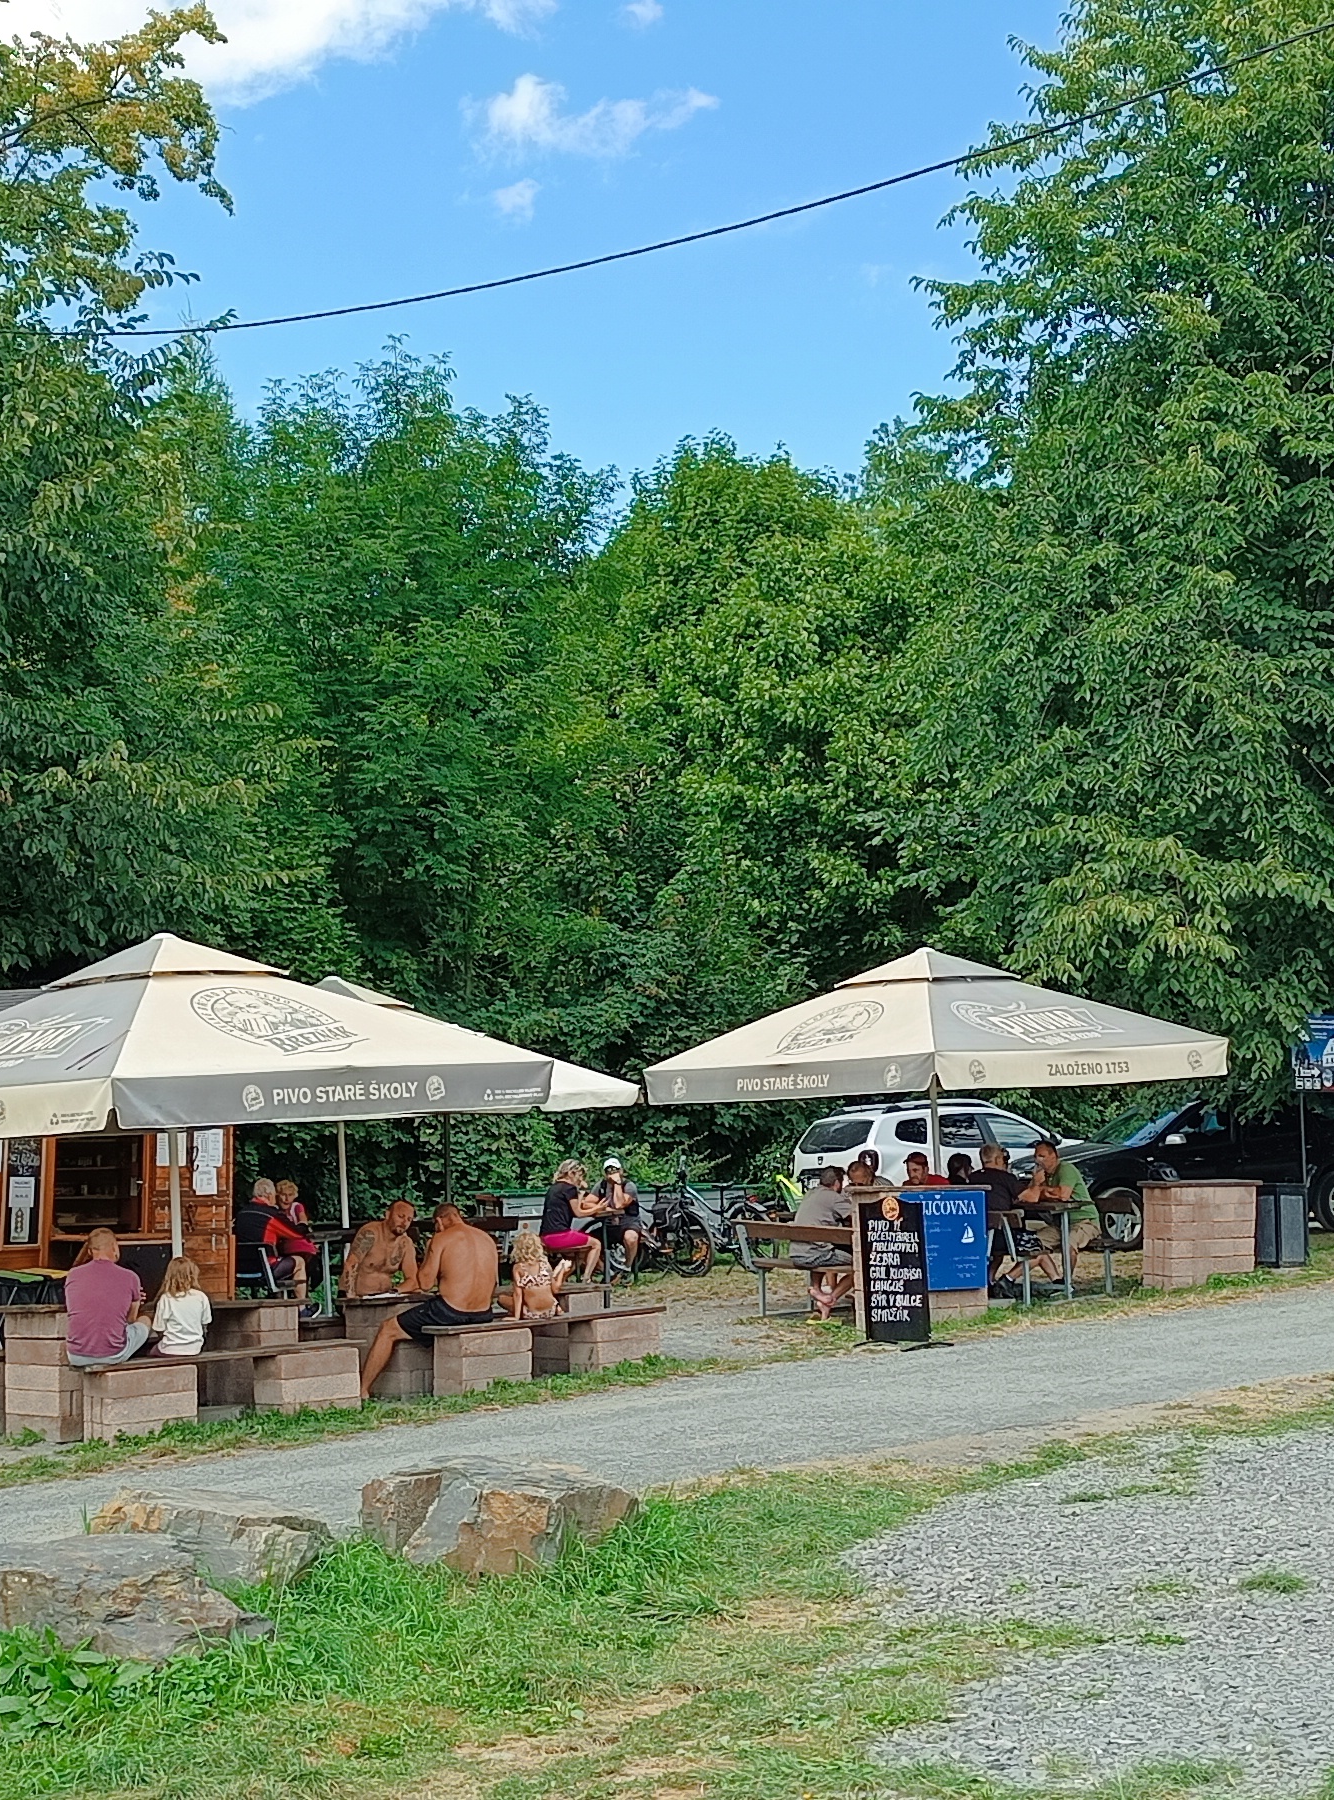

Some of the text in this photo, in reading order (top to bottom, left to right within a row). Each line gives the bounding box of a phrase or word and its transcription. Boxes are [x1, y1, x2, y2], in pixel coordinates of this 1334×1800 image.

[1047, 1060, 1130, 1077] ZALOŽENO 1753
[736, 1073, 830, 1092] PIVO STARÉ ŠKOLY
[272, 1080, 419, 1106] PIVO STARÉ ŠKOLY
[919, 1194, 978, 1216] JČOVNA
[867, 1219, 890, 1232] PIVO
[869, 1252, 901, 1266] ŽEBRA
